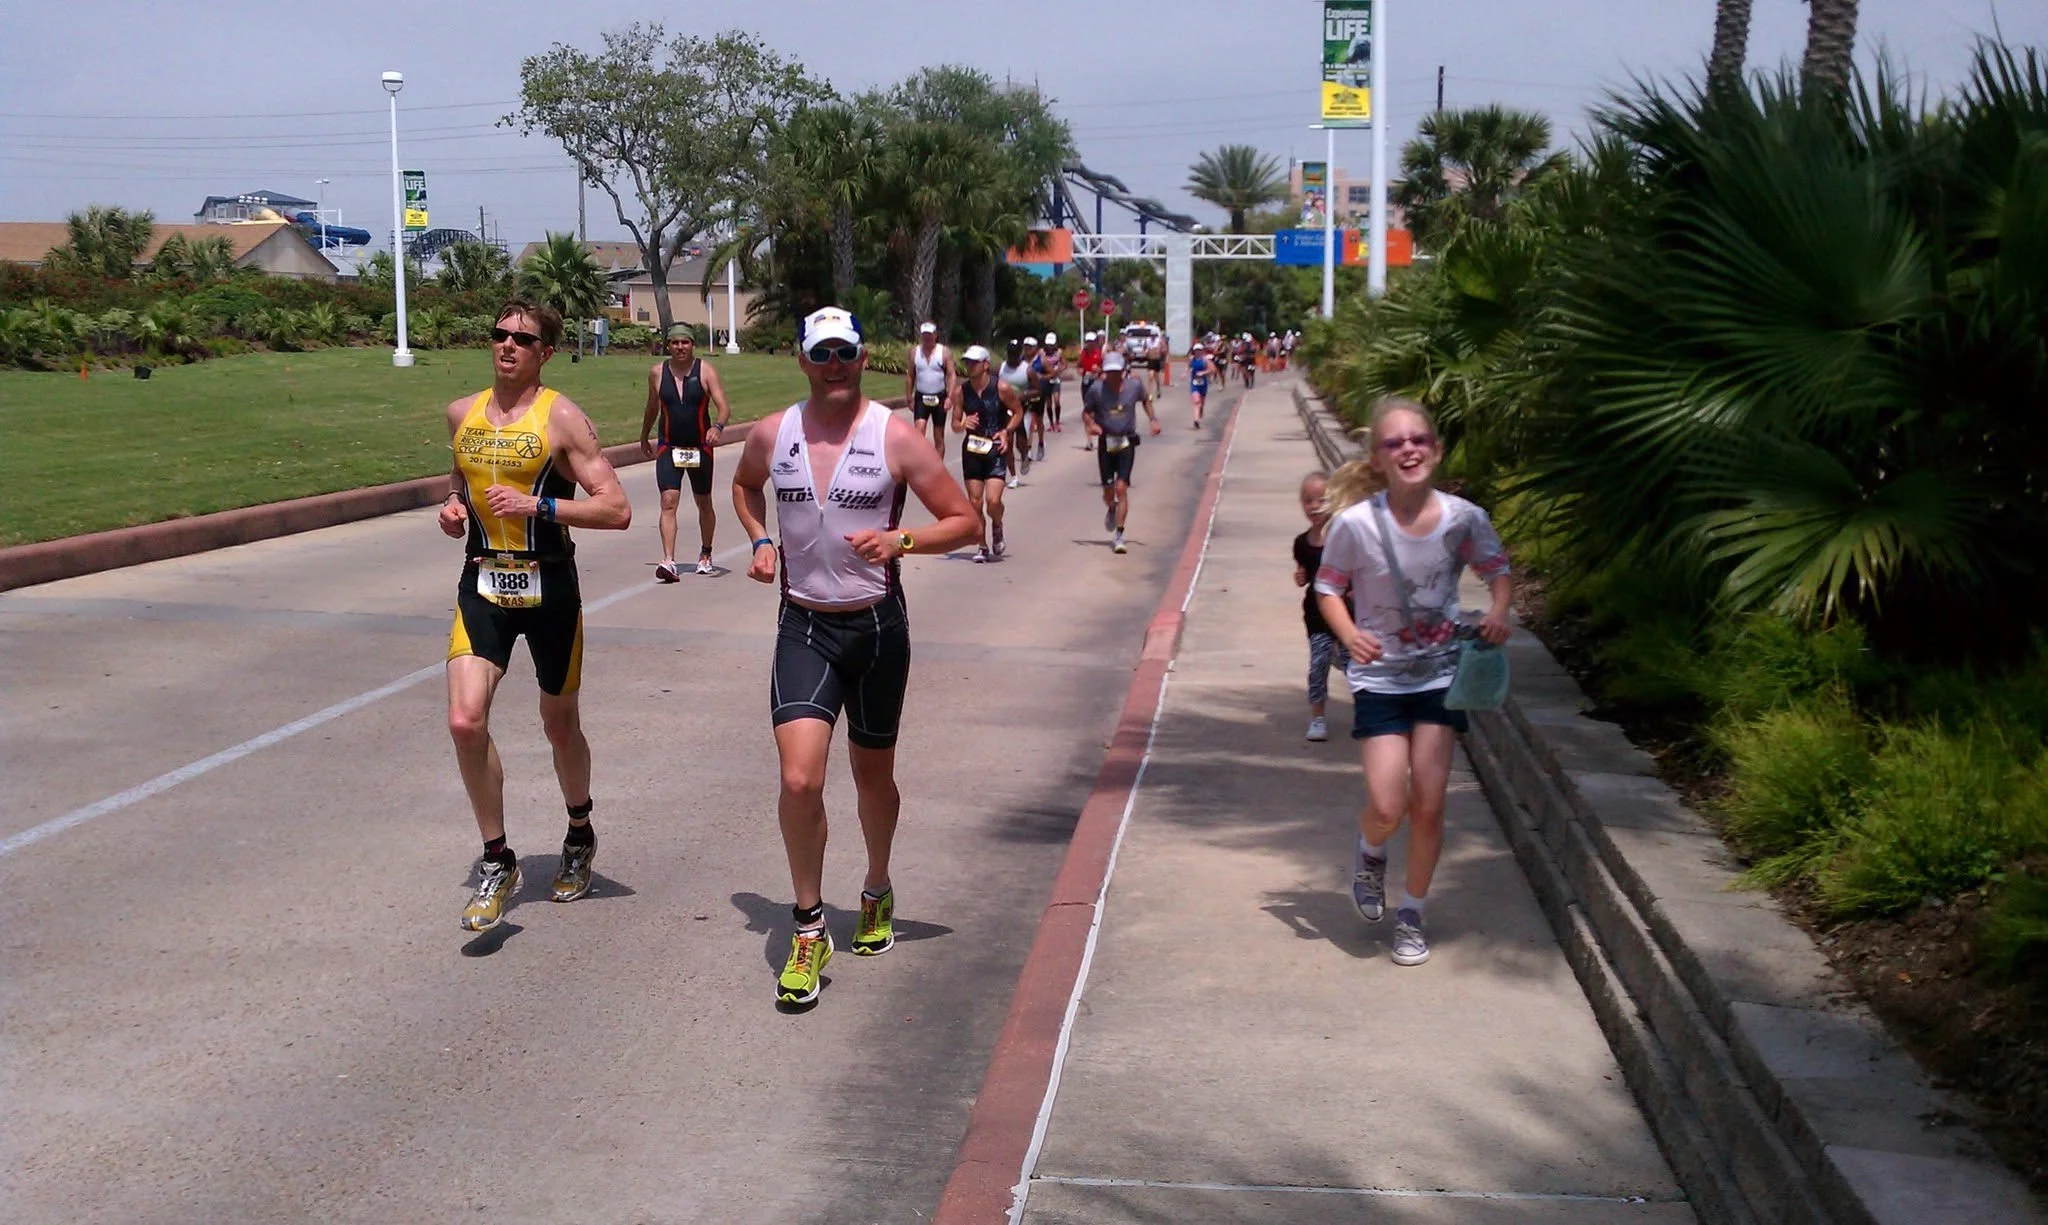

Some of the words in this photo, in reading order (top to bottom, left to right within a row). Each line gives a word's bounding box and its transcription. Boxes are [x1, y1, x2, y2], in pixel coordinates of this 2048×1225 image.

[1326, 20, 1368, 41] LIFE
[464, 427, 486, 437] TEAM
[461, 437, 515, 447] RIDGEWOOD
[458, 445, 483, 454] CYCLE
[489, 571, 529, 589] 1388
[495, 595, 524, 607] TEXAS
